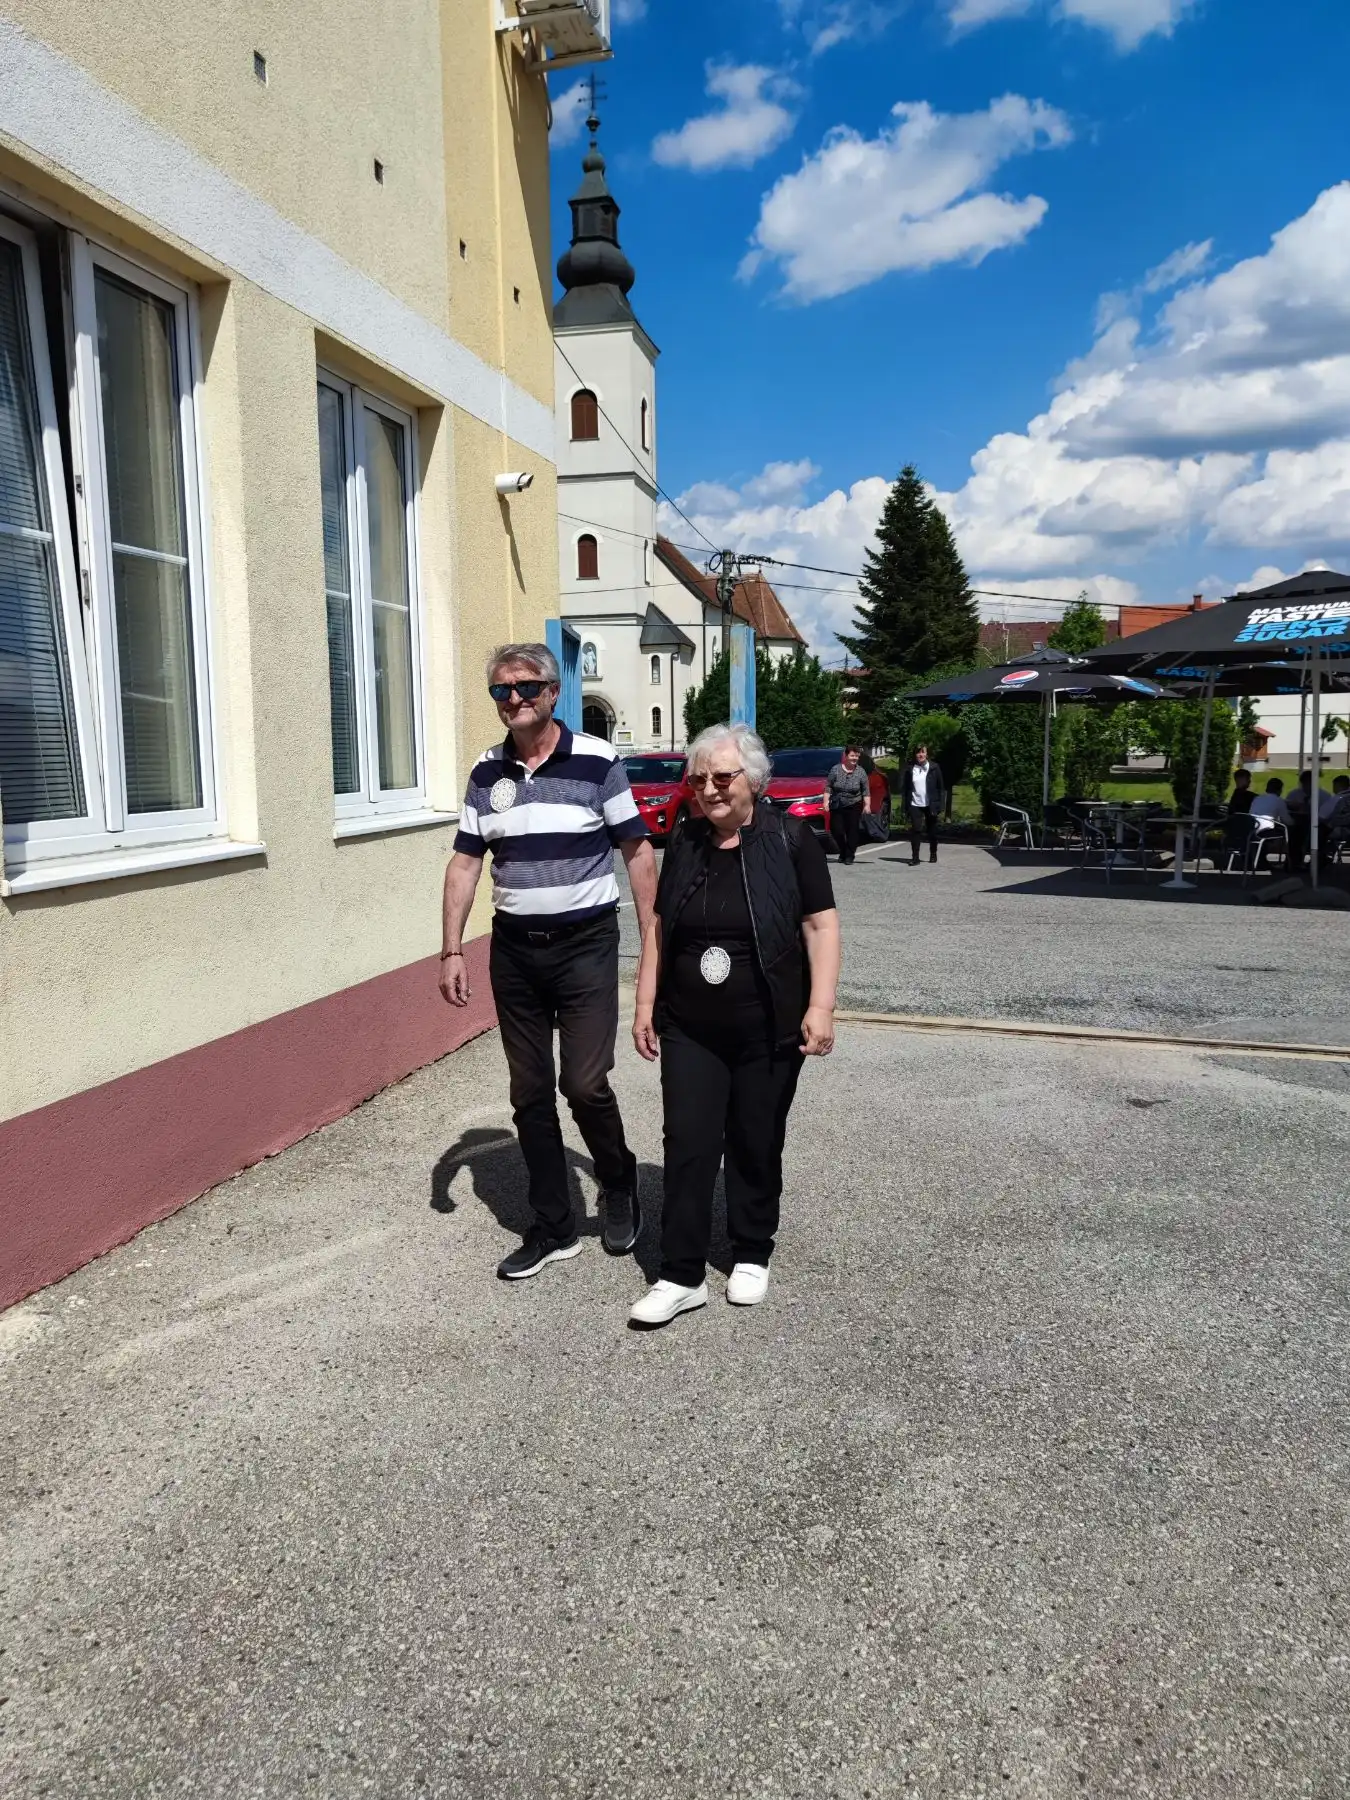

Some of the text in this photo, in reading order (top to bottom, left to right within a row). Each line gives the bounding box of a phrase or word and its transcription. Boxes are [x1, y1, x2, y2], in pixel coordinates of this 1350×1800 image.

[1247, 607, 1350, 624] TASTE
[1250, 601, 1350, 616] MAXIMUM
[1240, 616, 1350, 633] ZERO
[1233, 625, 1348, 642] SUGAR
